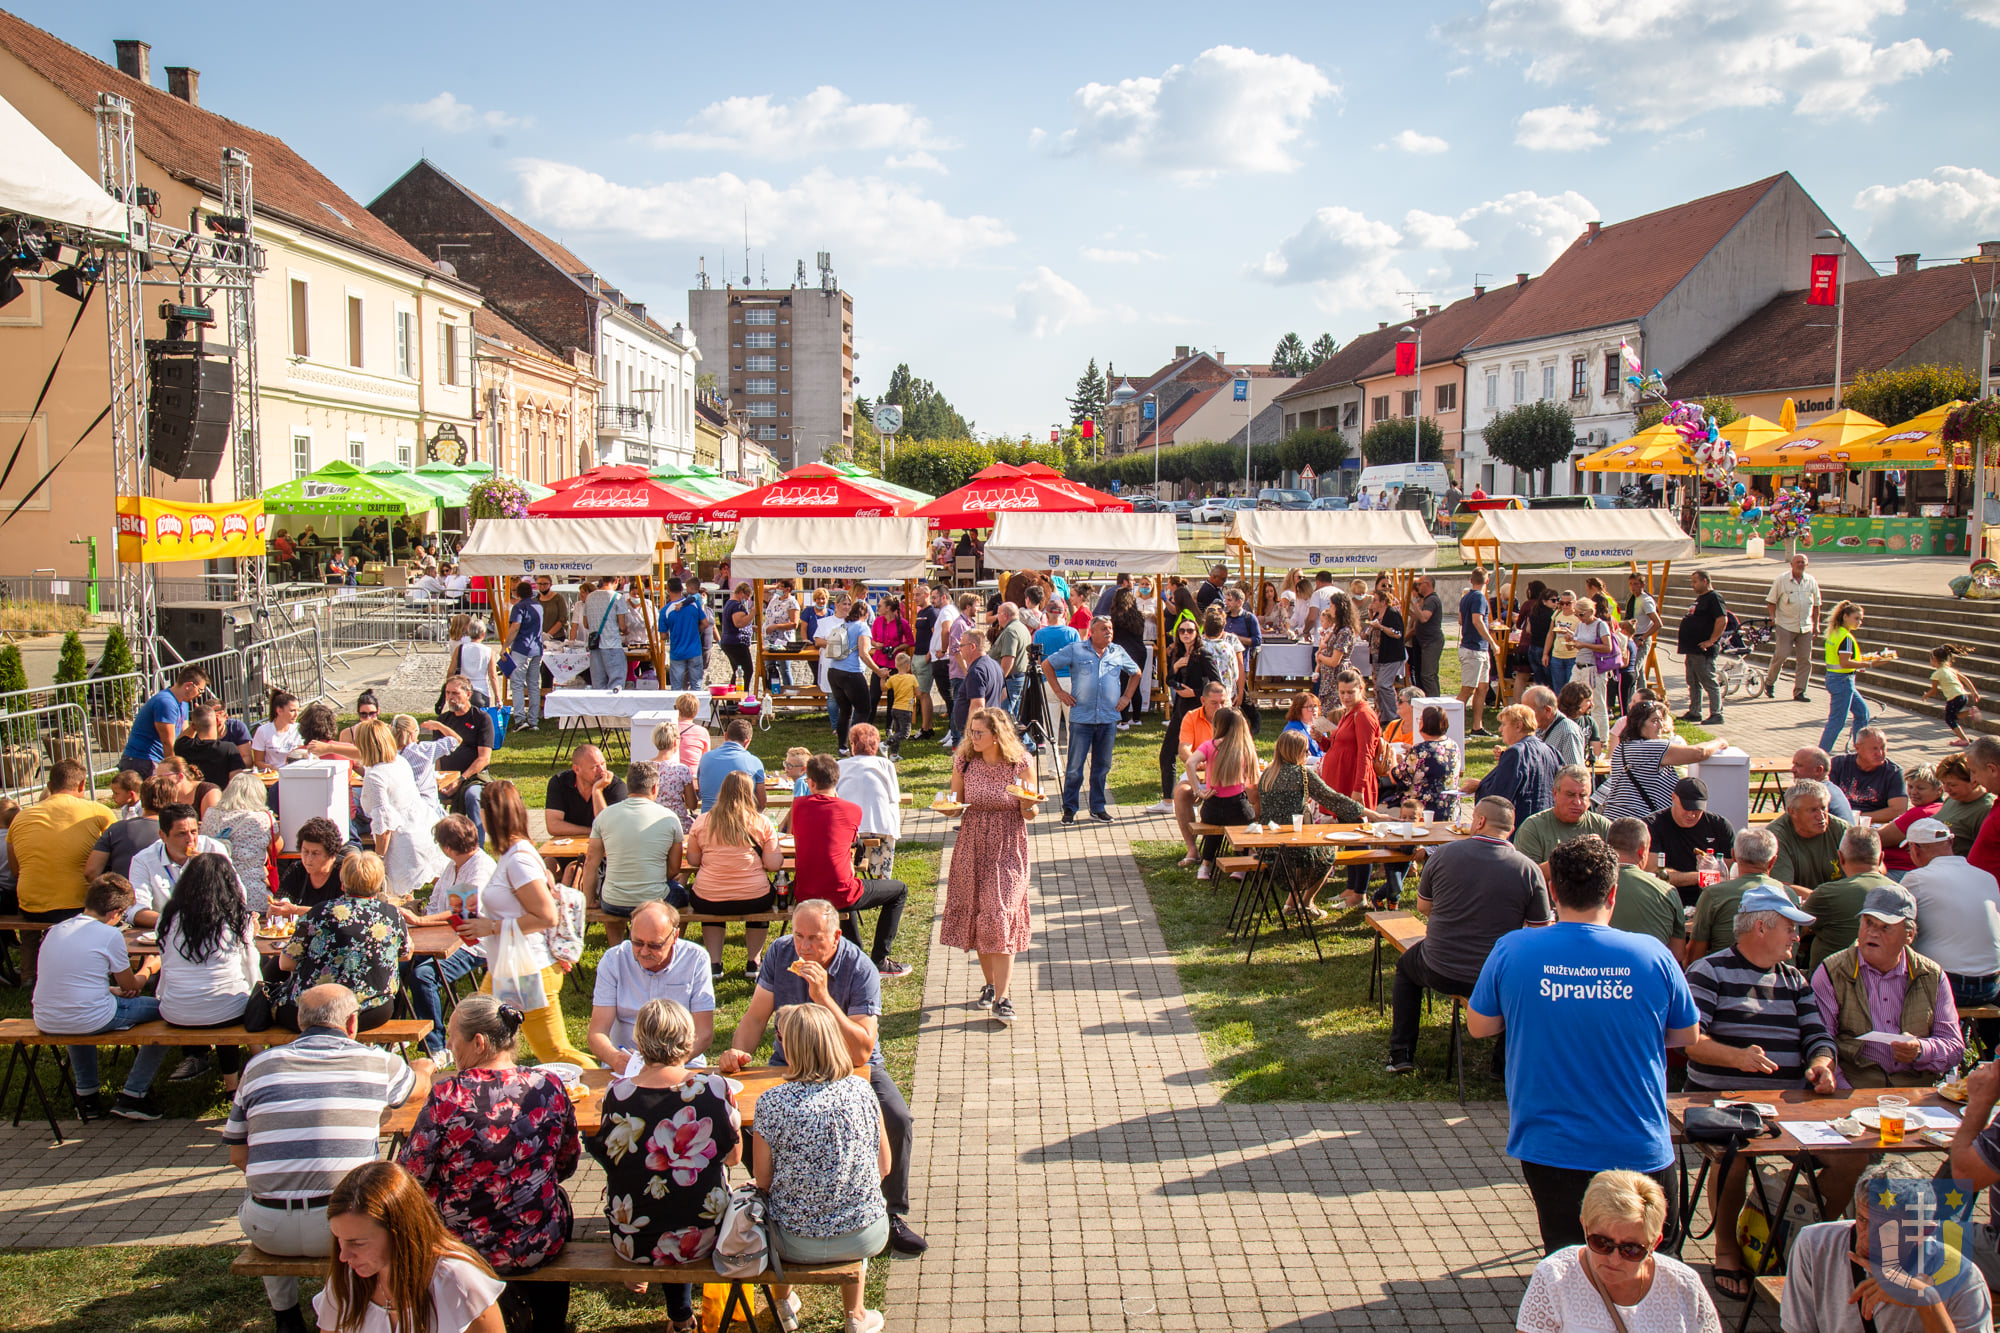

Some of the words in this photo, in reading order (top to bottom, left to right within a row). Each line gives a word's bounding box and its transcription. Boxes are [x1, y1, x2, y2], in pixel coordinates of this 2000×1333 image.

[368, 504, 385, 512] CRAFT
[387, 504, 400, 512] BEER
[1580, 549, 1600, 557] GRAD
[1601, 547, 1633, 557] KRIŽEVCI
[1064, 559, 1084, 567] GRAD
[1085, 557, 1117, 567] KRIŽEVCI
[1325, 555, 1344, 564] GRAD
[1345, 553, 1378, 563] KRIŽEVCI
[560, 561, 593, 570] KRIŽEVCI
[812, 566, 831, 574] GRAD
[833, 563, 866, 574] KRIŽEVCI
[1543, 964, 1598, 977] KRIŽEVAČKO
[1600, 966, 1631, 976] VELIKO
[1539, 978, 1633, 1001] Spravišče
